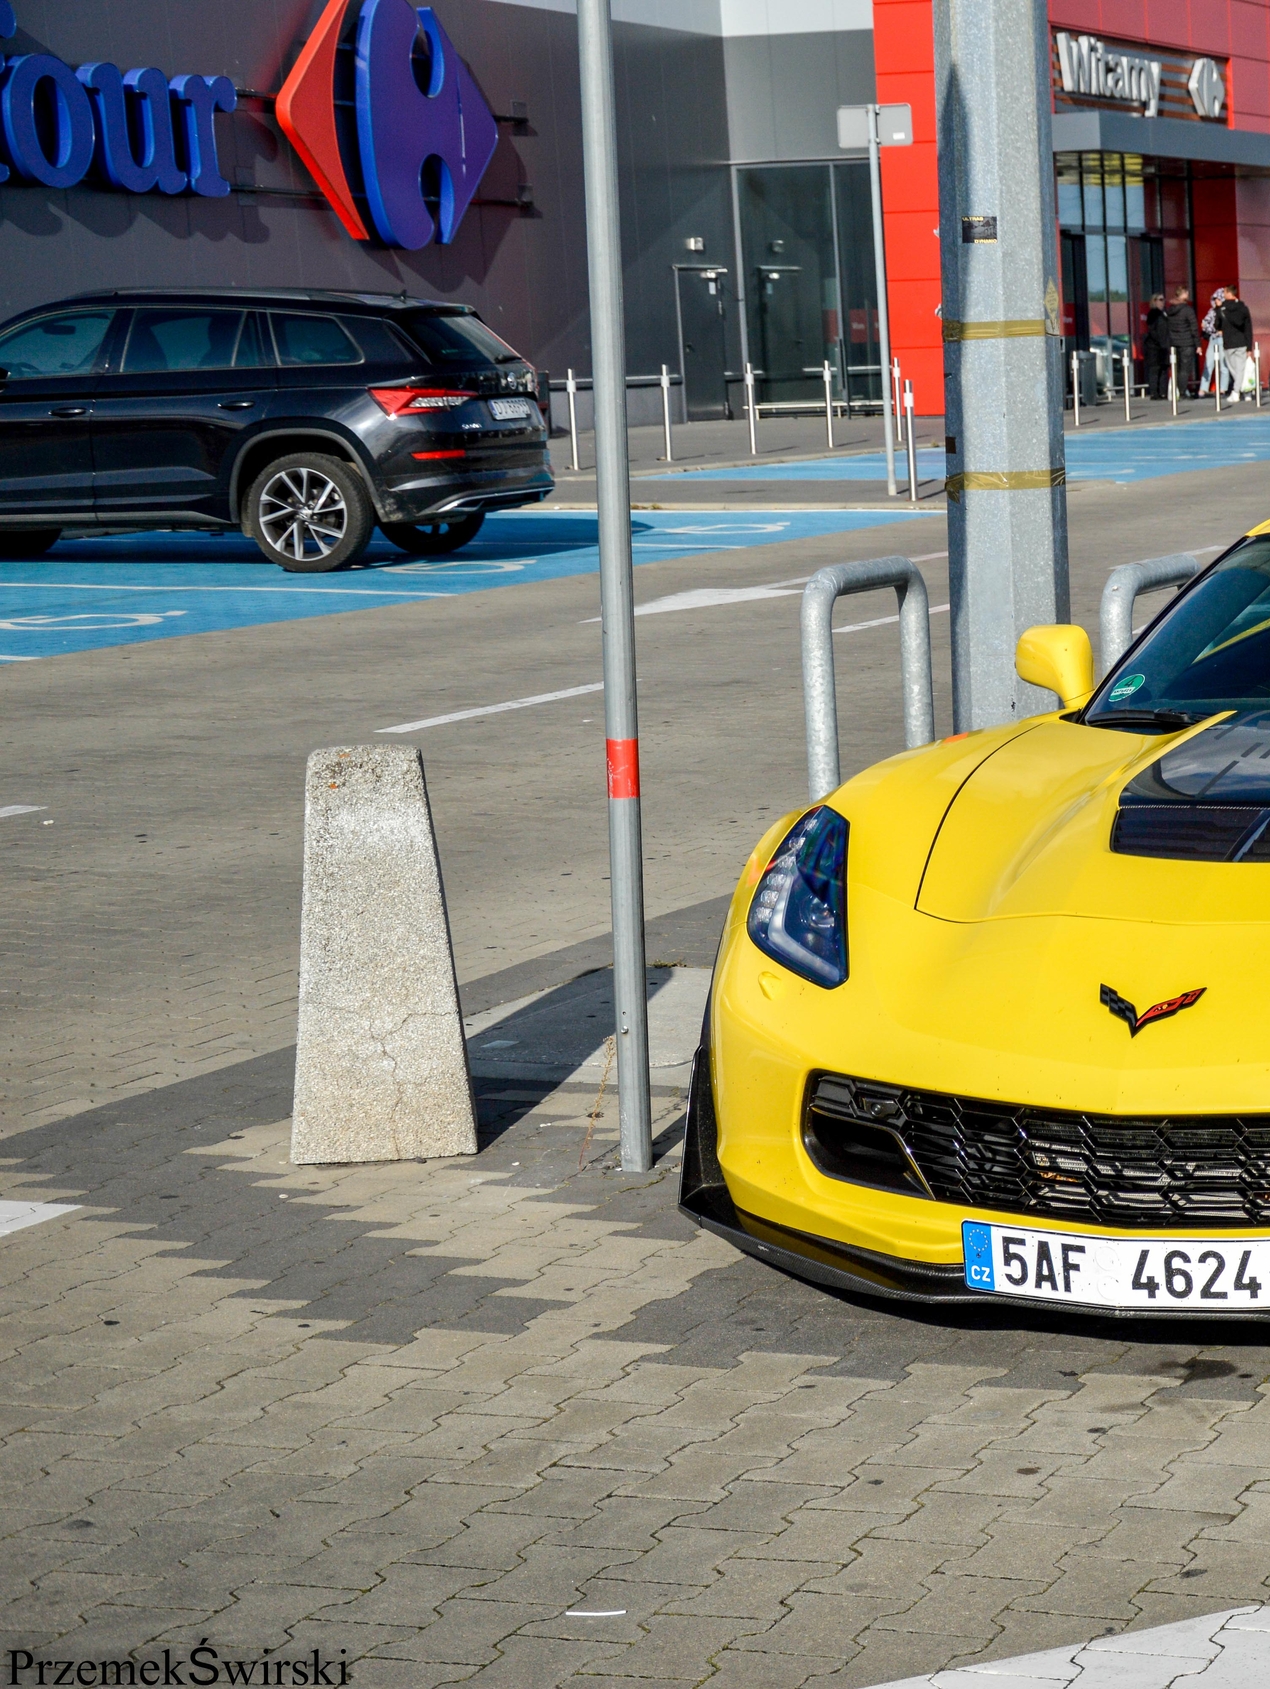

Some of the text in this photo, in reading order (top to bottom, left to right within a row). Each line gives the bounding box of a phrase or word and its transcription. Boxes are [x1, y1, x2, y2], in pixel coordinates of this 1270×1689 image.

[0, 0, 237, 197] our
[1056, 31, 1162, 118] Witamy
[971, 1265, 991, 1282] CZ
[1001, 1235, 1262, 1299] 5AF 4624
